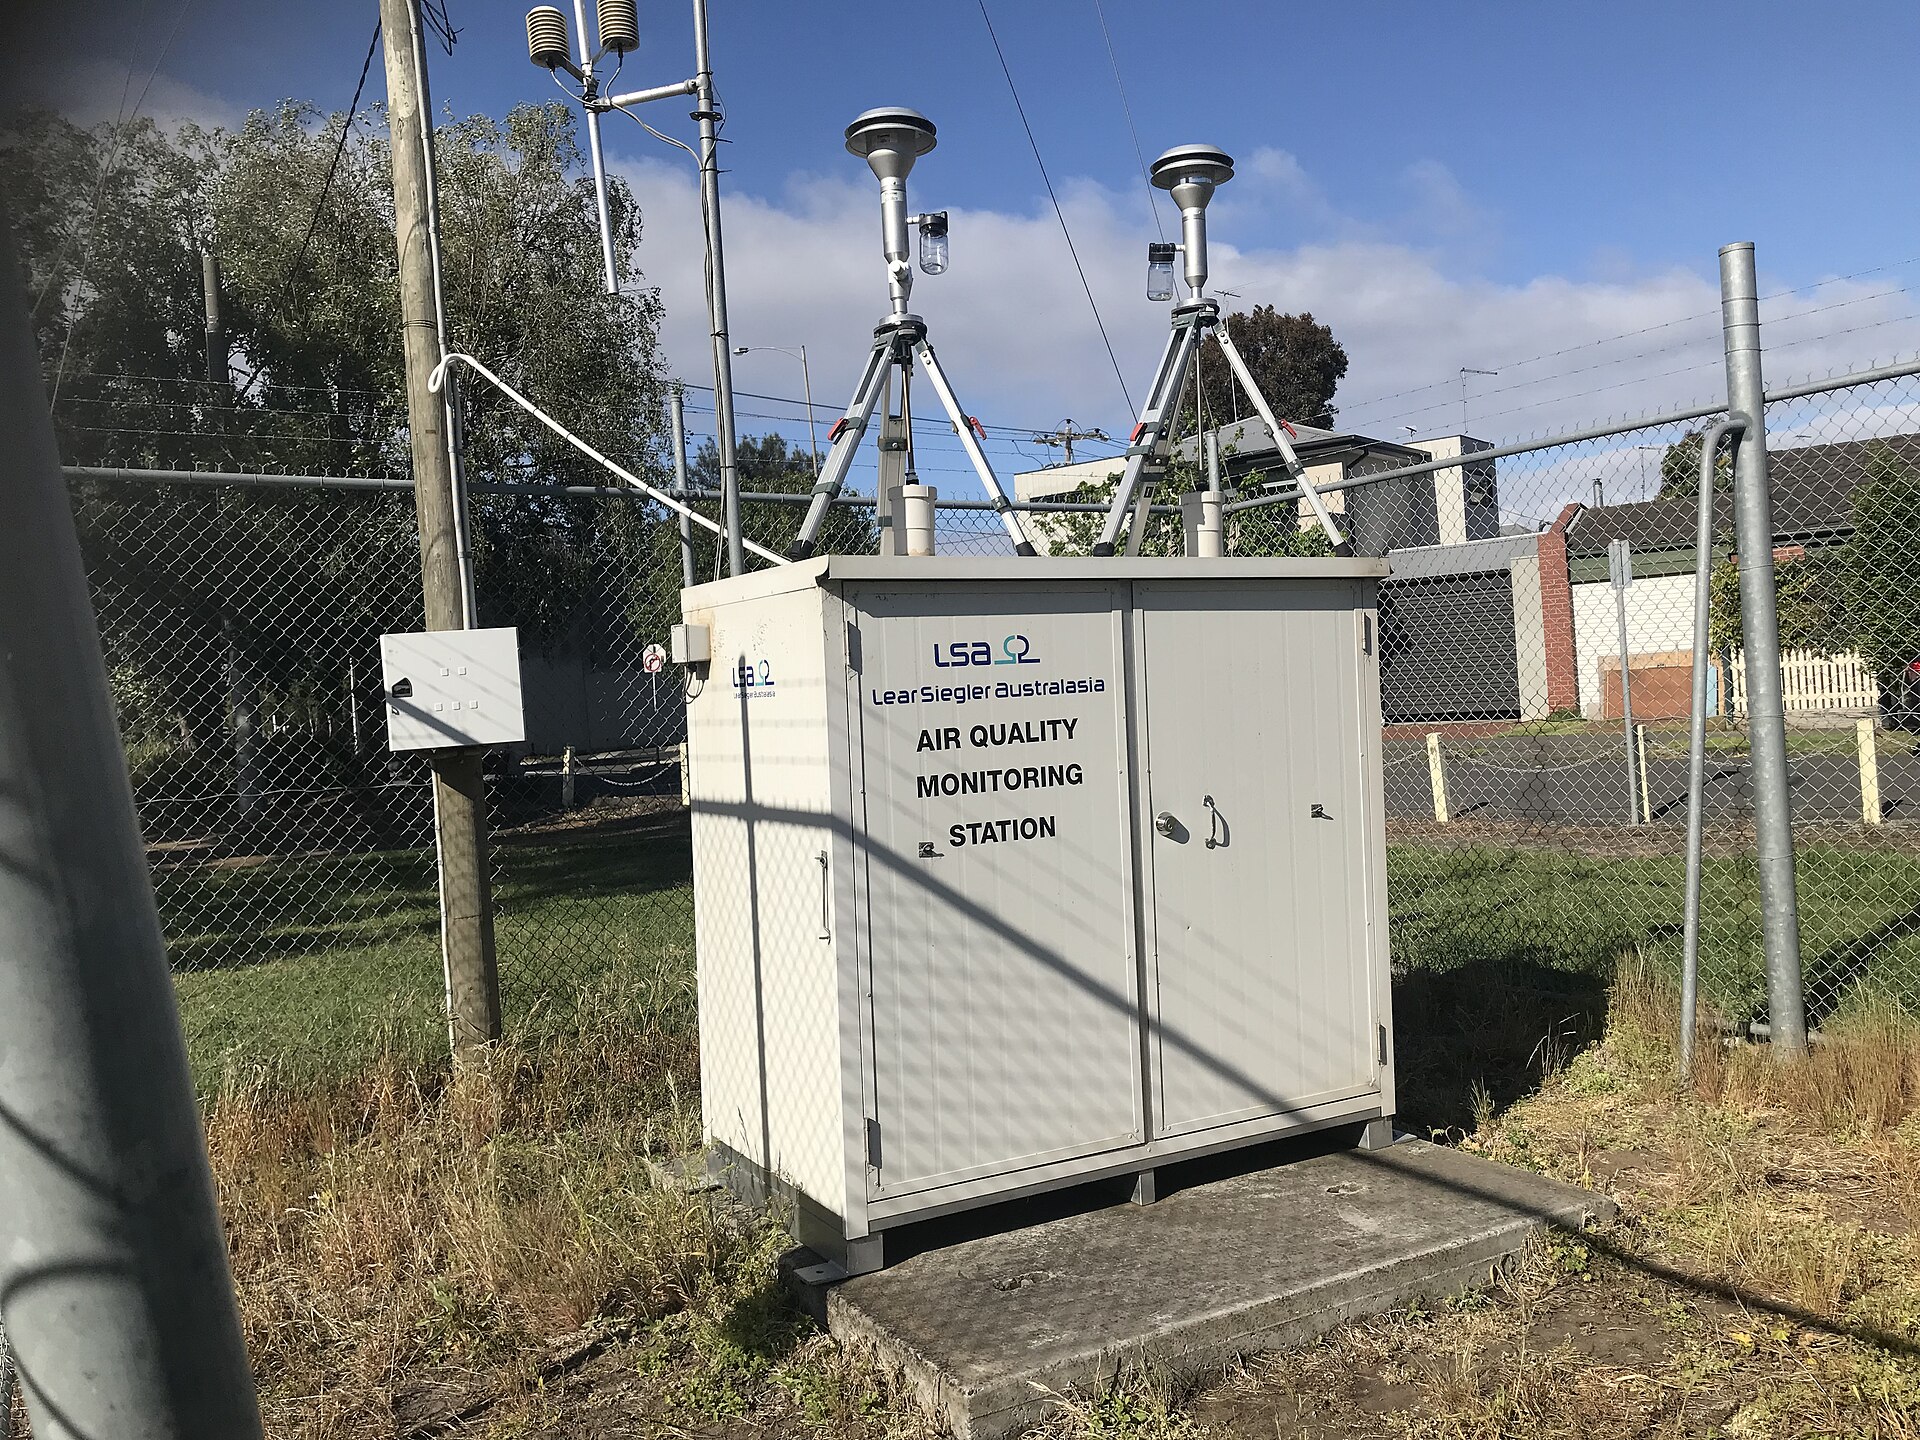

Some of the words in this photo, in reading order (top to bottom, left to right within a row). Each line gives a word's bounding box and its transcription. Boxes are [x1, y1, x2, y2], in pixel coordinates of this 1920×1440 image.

[872, 688, 917, 705] Lear
[921, 683, 991, 704] Siegler
[916, 727, 962, 752] AIR
[969, 718, 1078, 748] QUALITY
[916, 763, 1083, 798] MONITORING
[949, 816, 1056, 847] STATION
